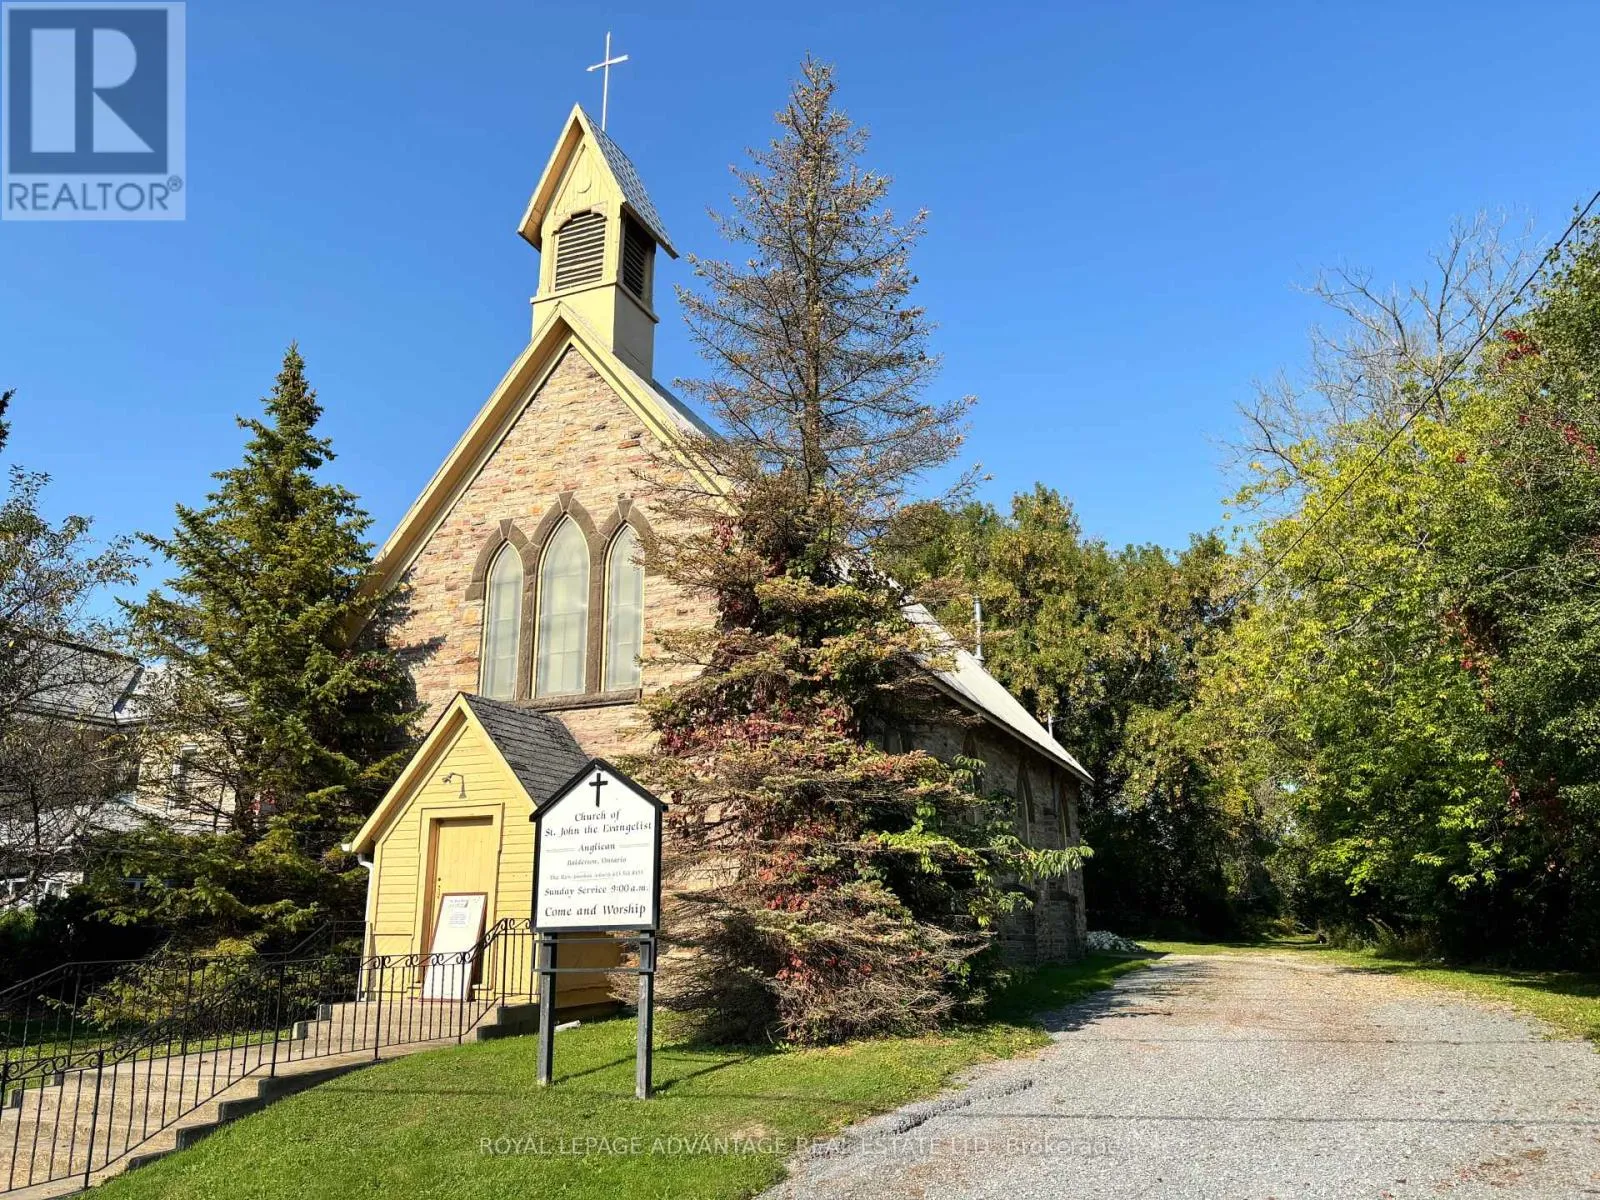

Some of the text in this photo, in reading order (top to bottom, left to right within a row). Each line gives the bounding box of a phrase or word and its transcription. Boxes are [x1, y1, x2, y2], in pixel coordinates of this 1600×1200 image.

[574, 808, 621, 821] Church of
[544, 822, 652, 837] St. John the Evangelist
[578, 843, 616, 854] Anglican
[544, 887, 575, 898] Sunday
[577, 885, 607, 895] Service
[544, 904, 646, 918] Come and Worship
